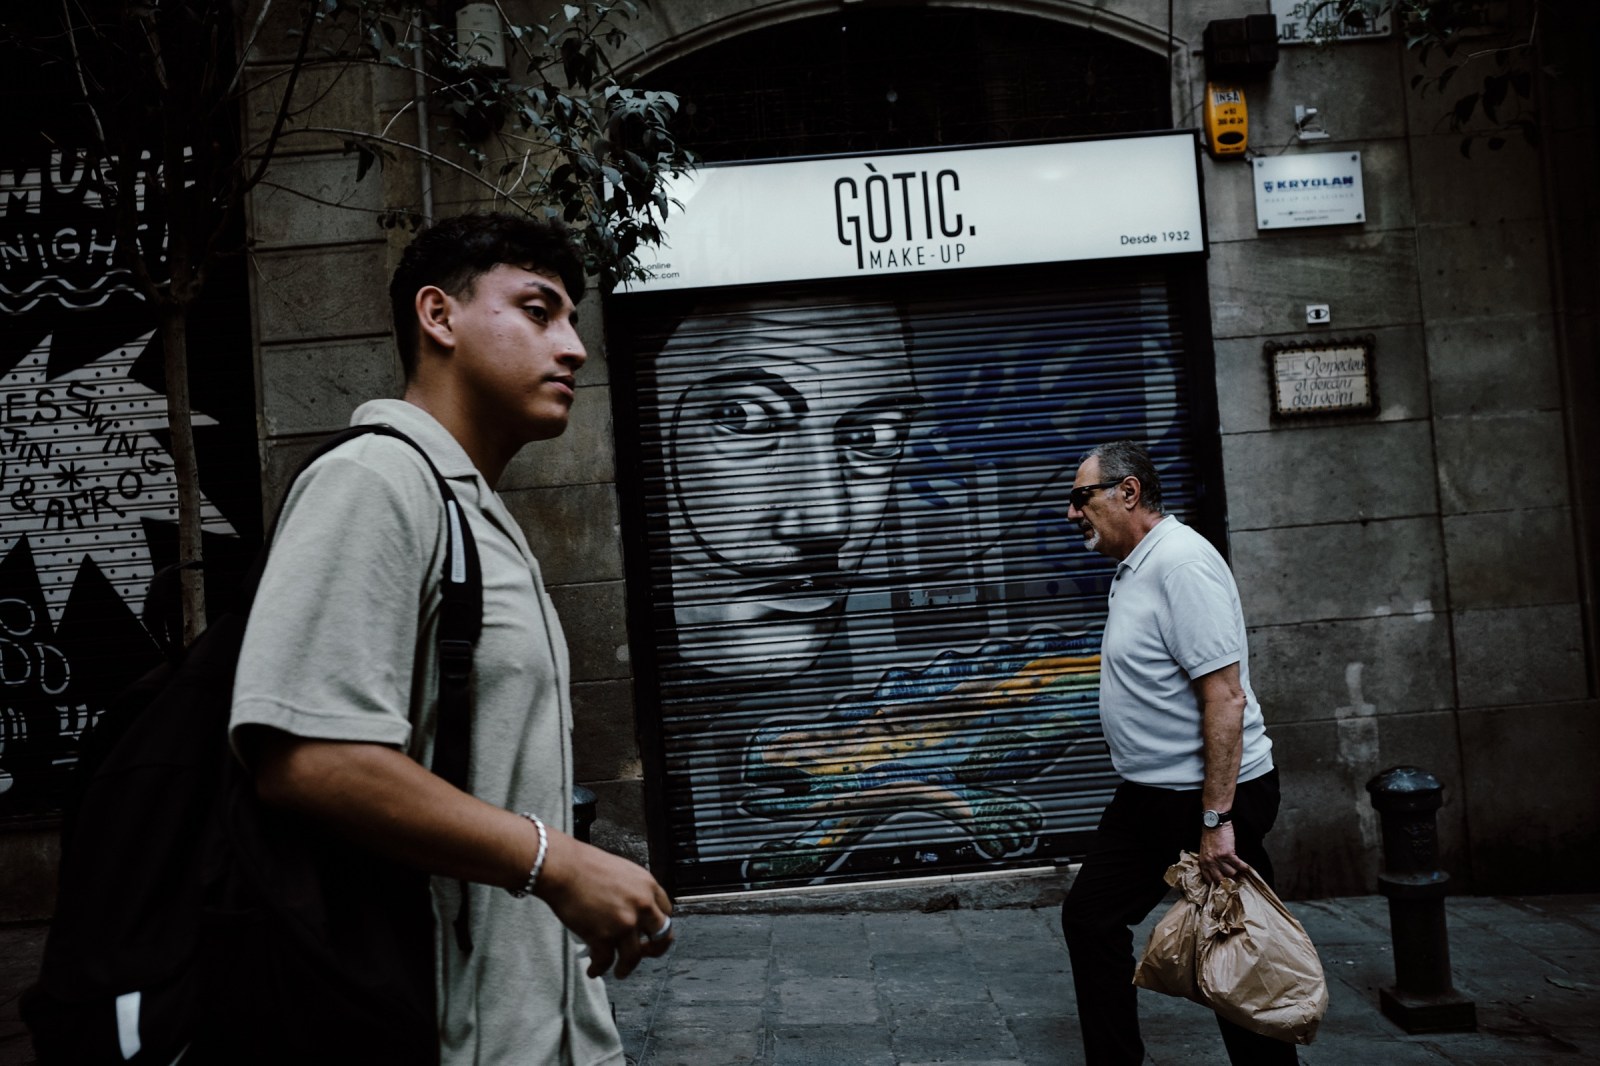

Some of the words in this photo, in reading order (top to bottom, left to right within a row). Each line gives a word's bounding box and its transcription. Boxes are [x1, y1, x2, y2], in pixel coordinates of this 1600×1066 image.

[1282, 23, 1300, 40] DE
[1216, 91, 1239, 104] INSA
[1277, 176, 1353, 189] KRYOLAN
[1120, 233, 1157, 247] Desde
[1161, 230, 1191, 243] 1932
[869, 243, 966, 269] MAKE-UP
[43, 468, 143, 530] AFRO
